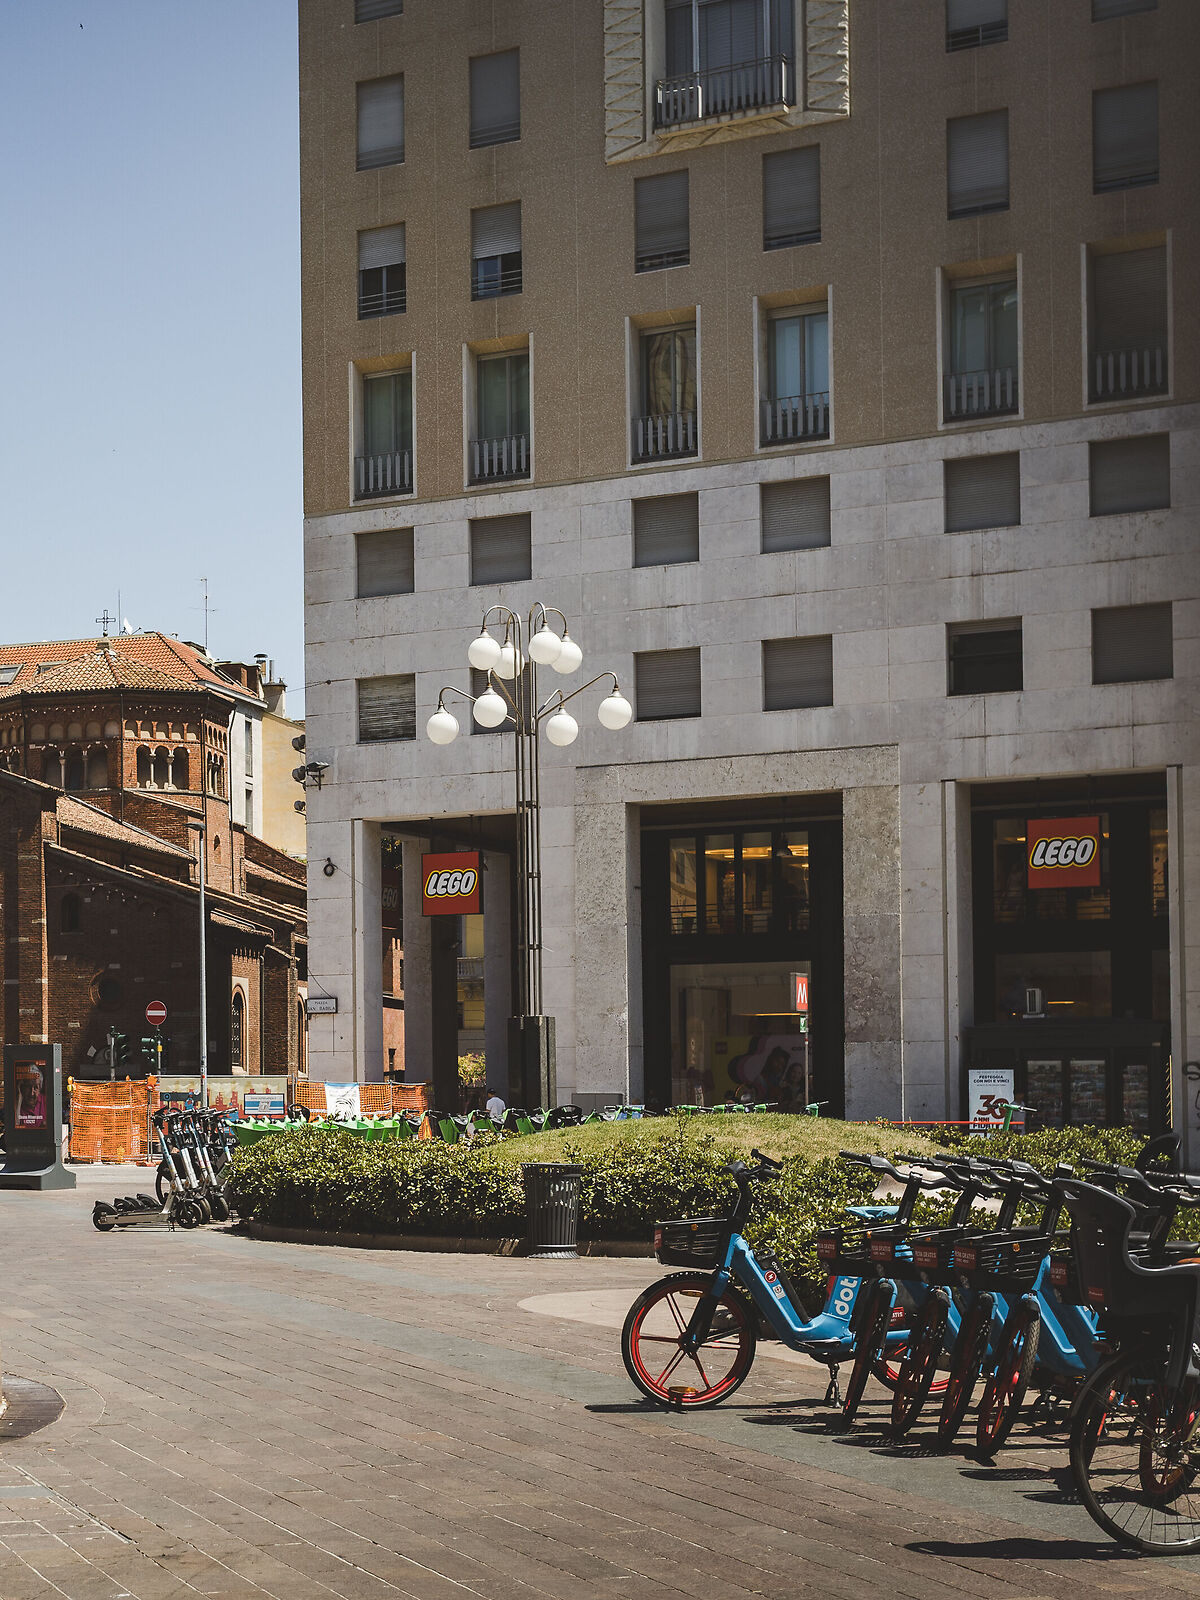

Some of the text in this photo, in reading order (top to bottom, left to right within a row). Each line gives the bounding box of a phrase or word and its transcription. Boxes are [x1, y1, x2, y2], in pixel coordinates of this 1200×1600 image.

[1031, 837, 1096, 868] LEGO
[425, 869, 477, 897] LEGO
[797, 983, 808, 1004] M
[834, 1275, 859, 1316] dot
